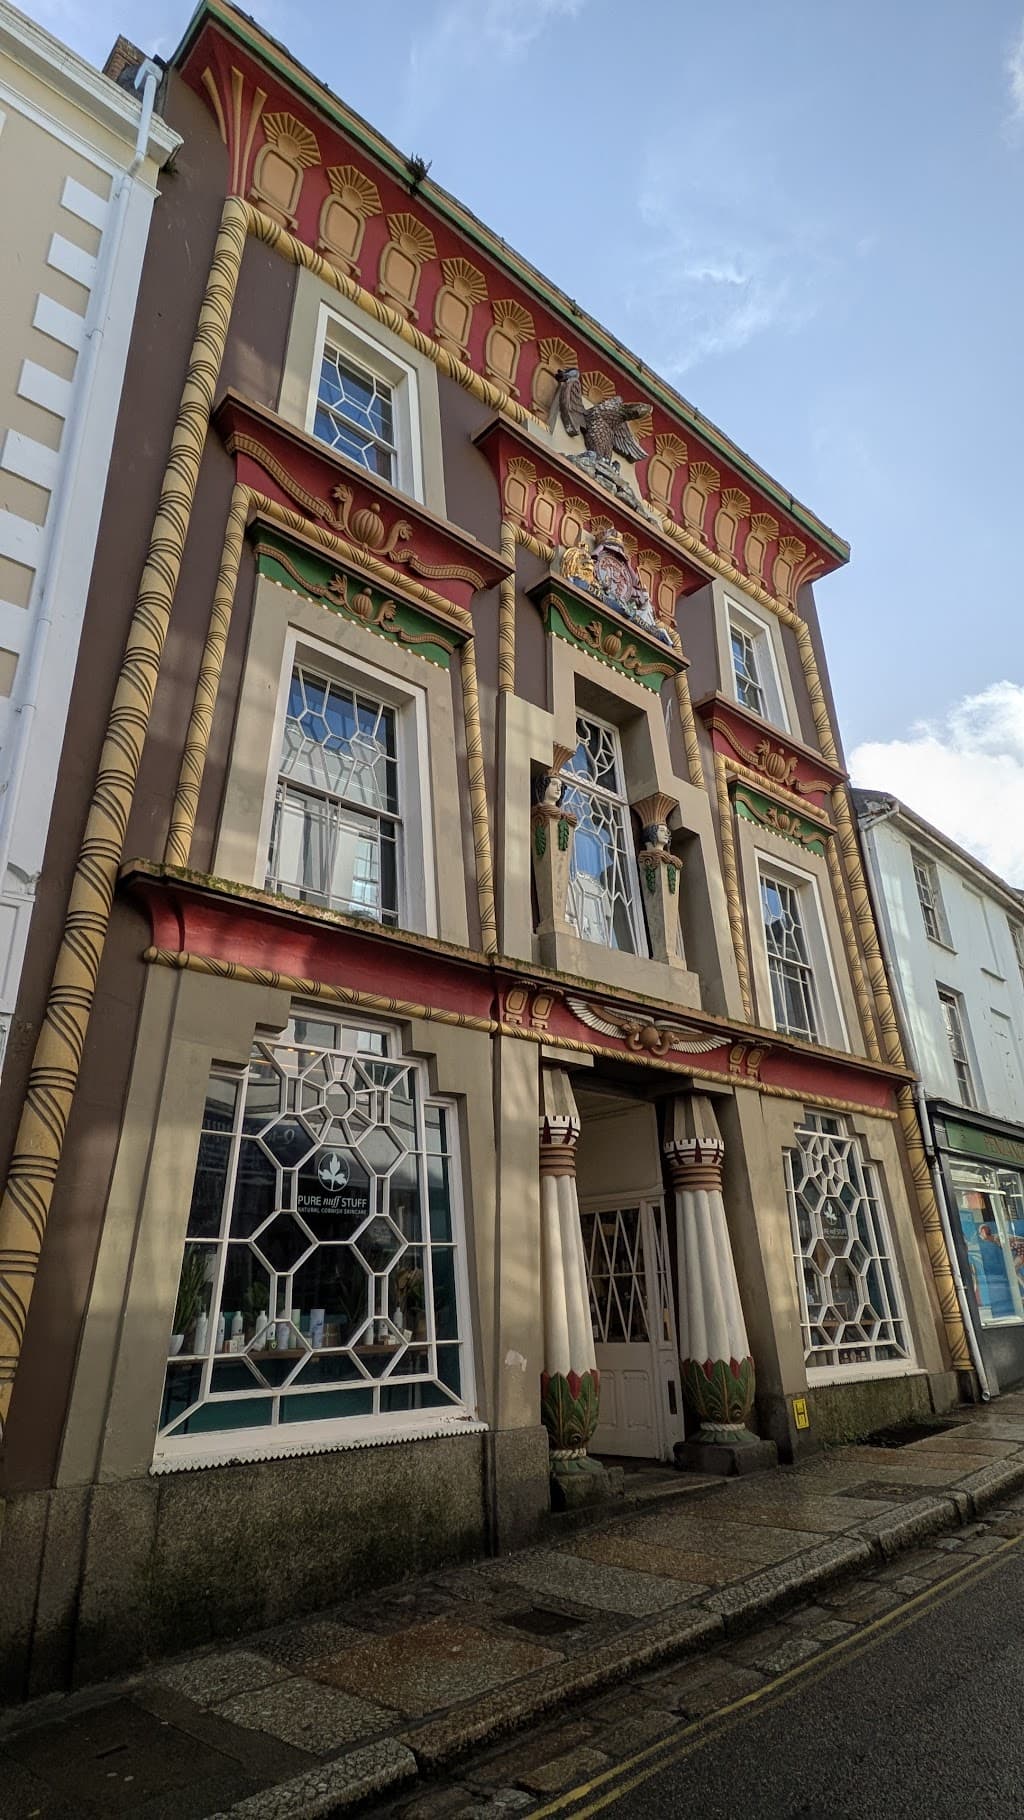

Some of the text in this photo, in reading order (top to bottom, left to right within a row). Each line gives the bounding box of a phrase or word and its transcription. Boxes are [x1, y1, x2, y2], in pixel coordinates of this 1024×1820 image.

[297, 1195, 367, 1208] PURE nuff STUFF
